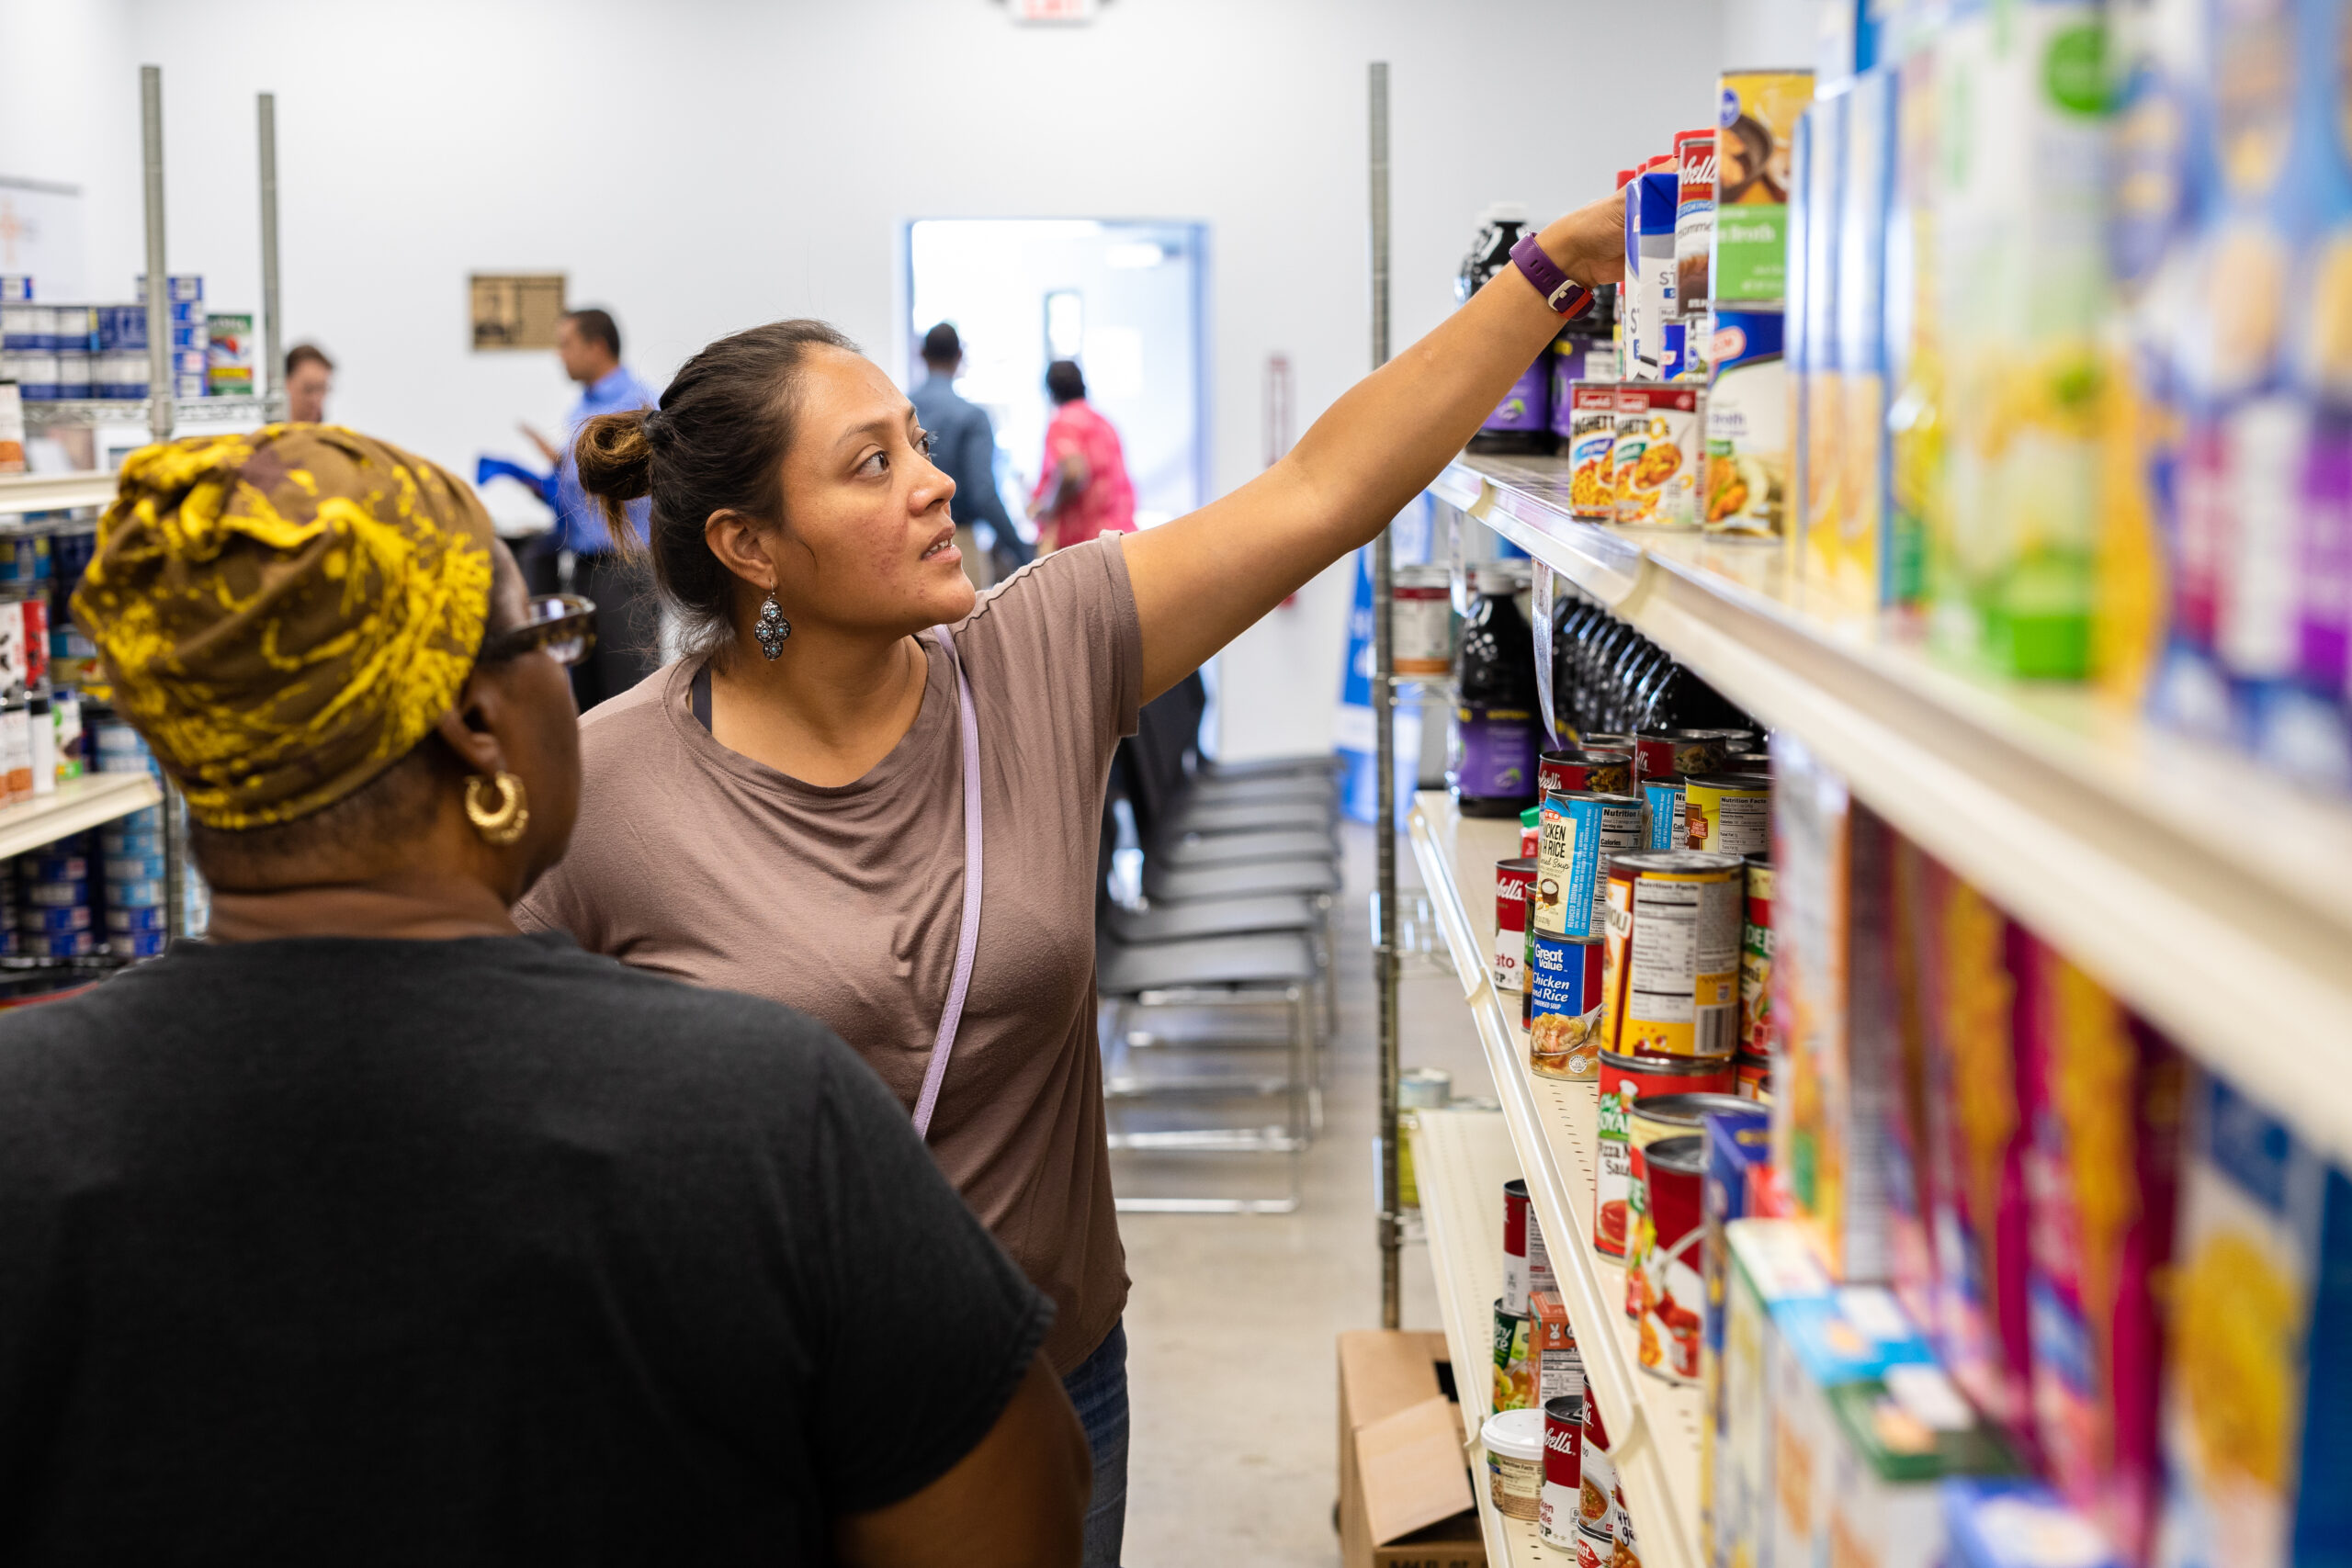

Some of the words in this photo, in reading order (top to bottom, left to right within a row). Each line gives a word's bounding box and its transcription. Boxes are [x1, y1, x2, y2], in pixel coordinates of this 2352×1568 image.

[1548, 842, 1566, 859] RICE
[1552, 859, 1570, 870] Soup
[1534, 943, 1564, 964] Great
[1538, 957, 1564, 972] Value
[1532, 972, 1570, 990] Chicken
[1543, 988, 1568, 1003] Rice
